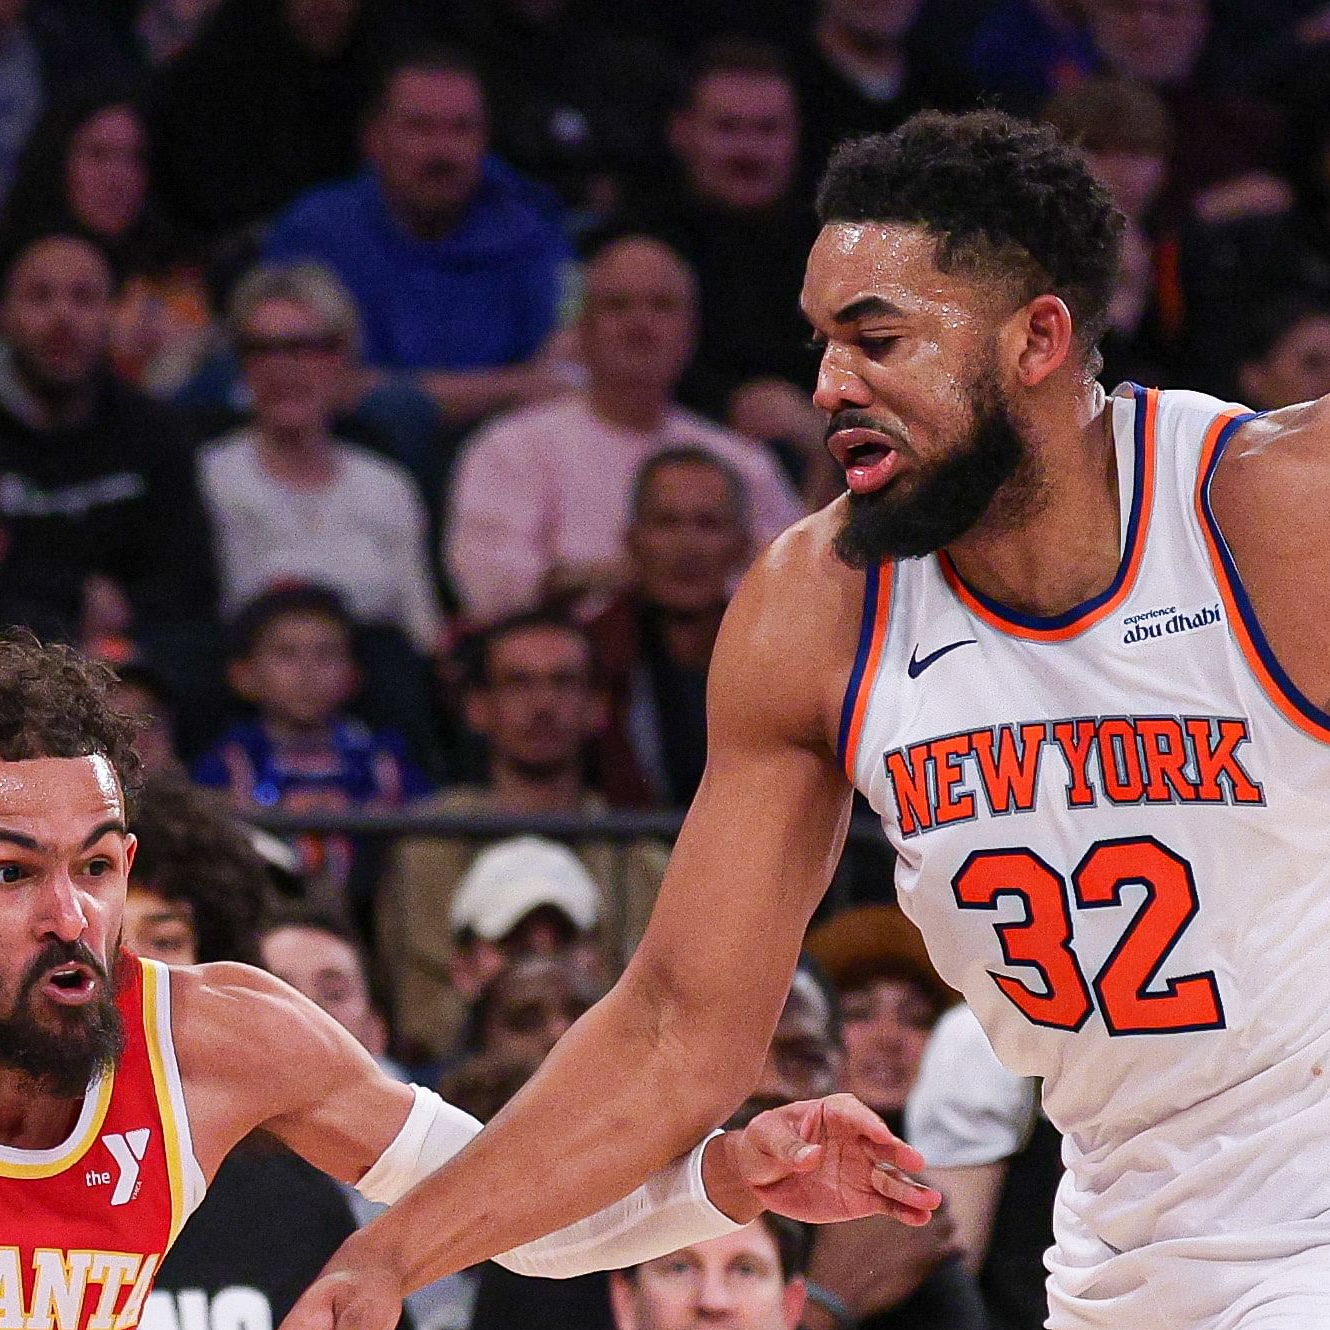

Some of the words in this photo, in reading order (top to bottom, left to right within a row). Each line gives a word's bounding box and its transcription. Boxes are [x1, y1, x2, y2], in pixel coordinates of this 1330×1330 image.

[1123, 606, 1177, 625] experience
[1123, 624, 1163, 644] abu
[883, 722, 1048, 840] NEW
[1050, 714, 1268, 810] YORK
[950, 835, 1227, 1038] 32
[85, 1169, 111, 1187] the
